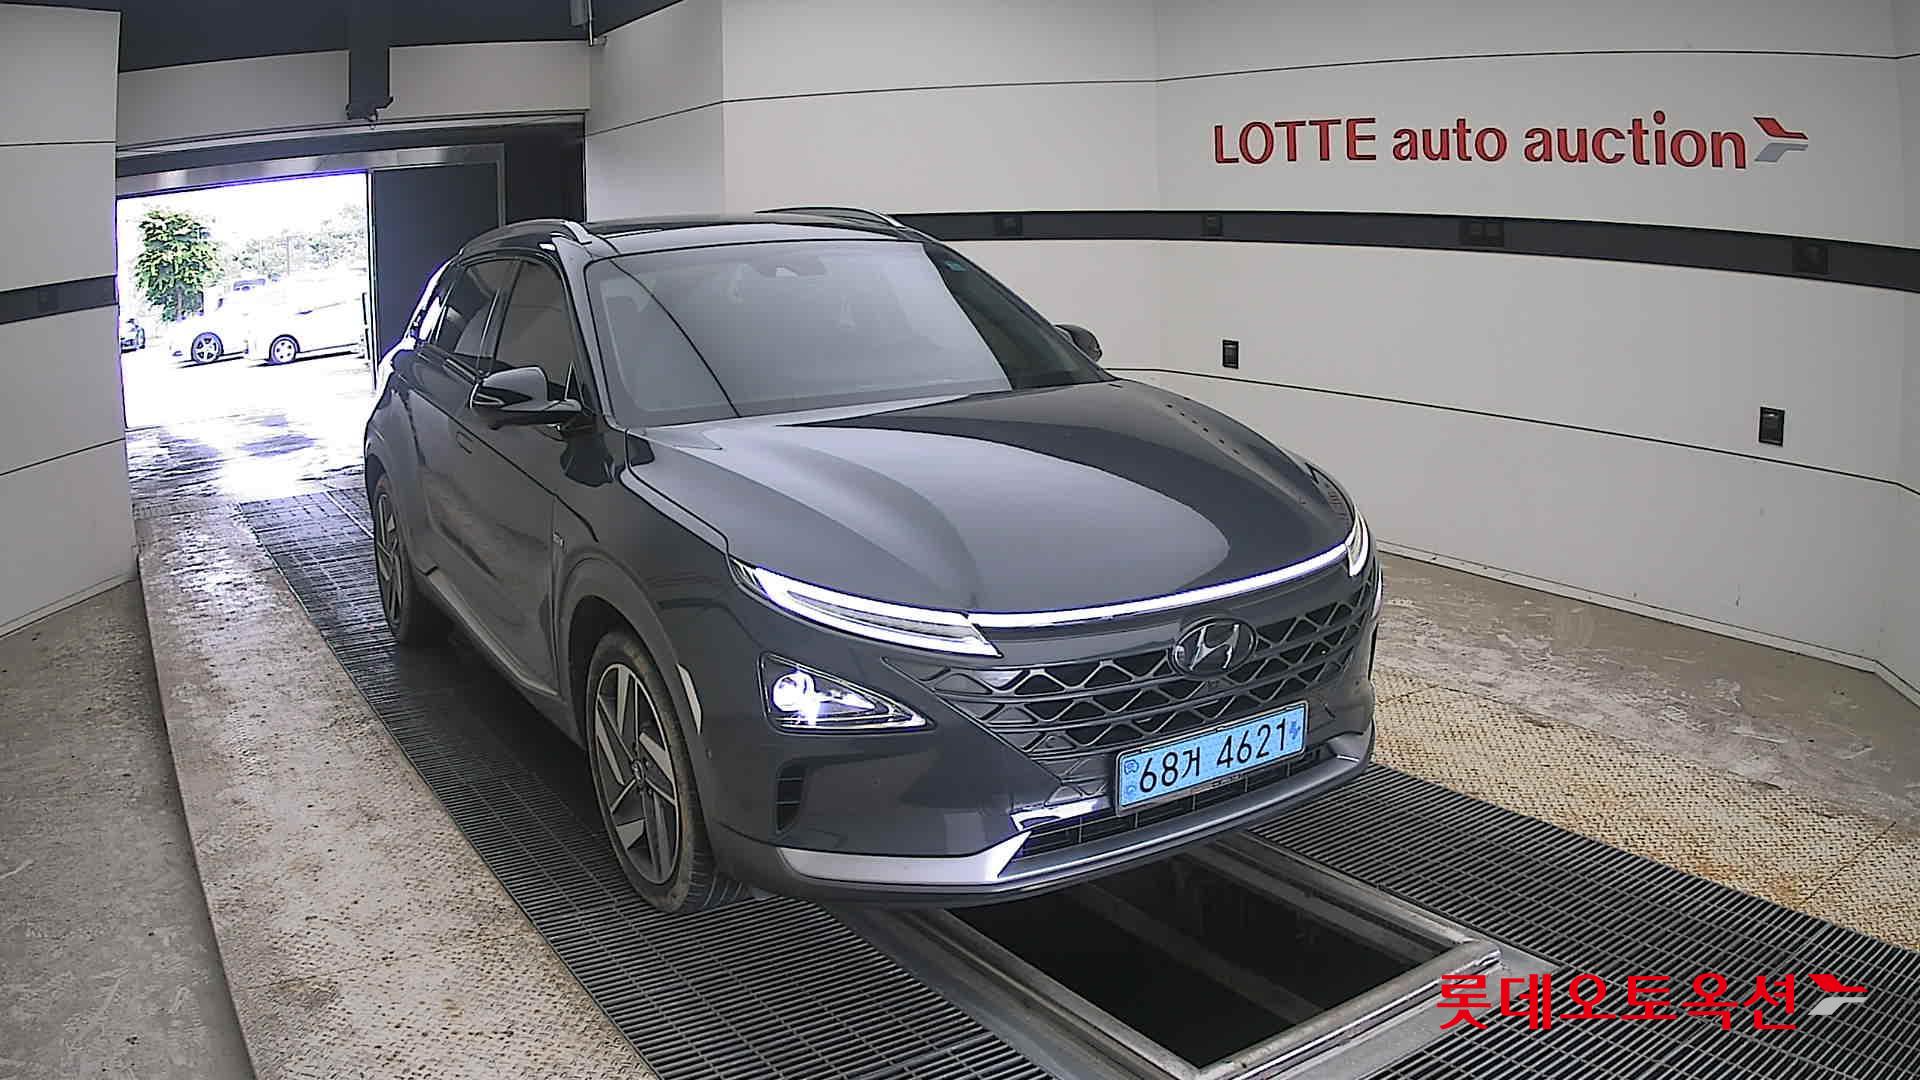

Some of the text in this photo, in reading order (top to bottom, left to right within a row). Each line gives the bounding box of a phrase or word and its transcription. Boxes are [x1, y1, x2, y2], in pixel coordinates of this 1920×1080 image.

[1213, 110, 1747, 169] LOTTE auto auction
[1139, 718, 1286, 793] 68거 4621
